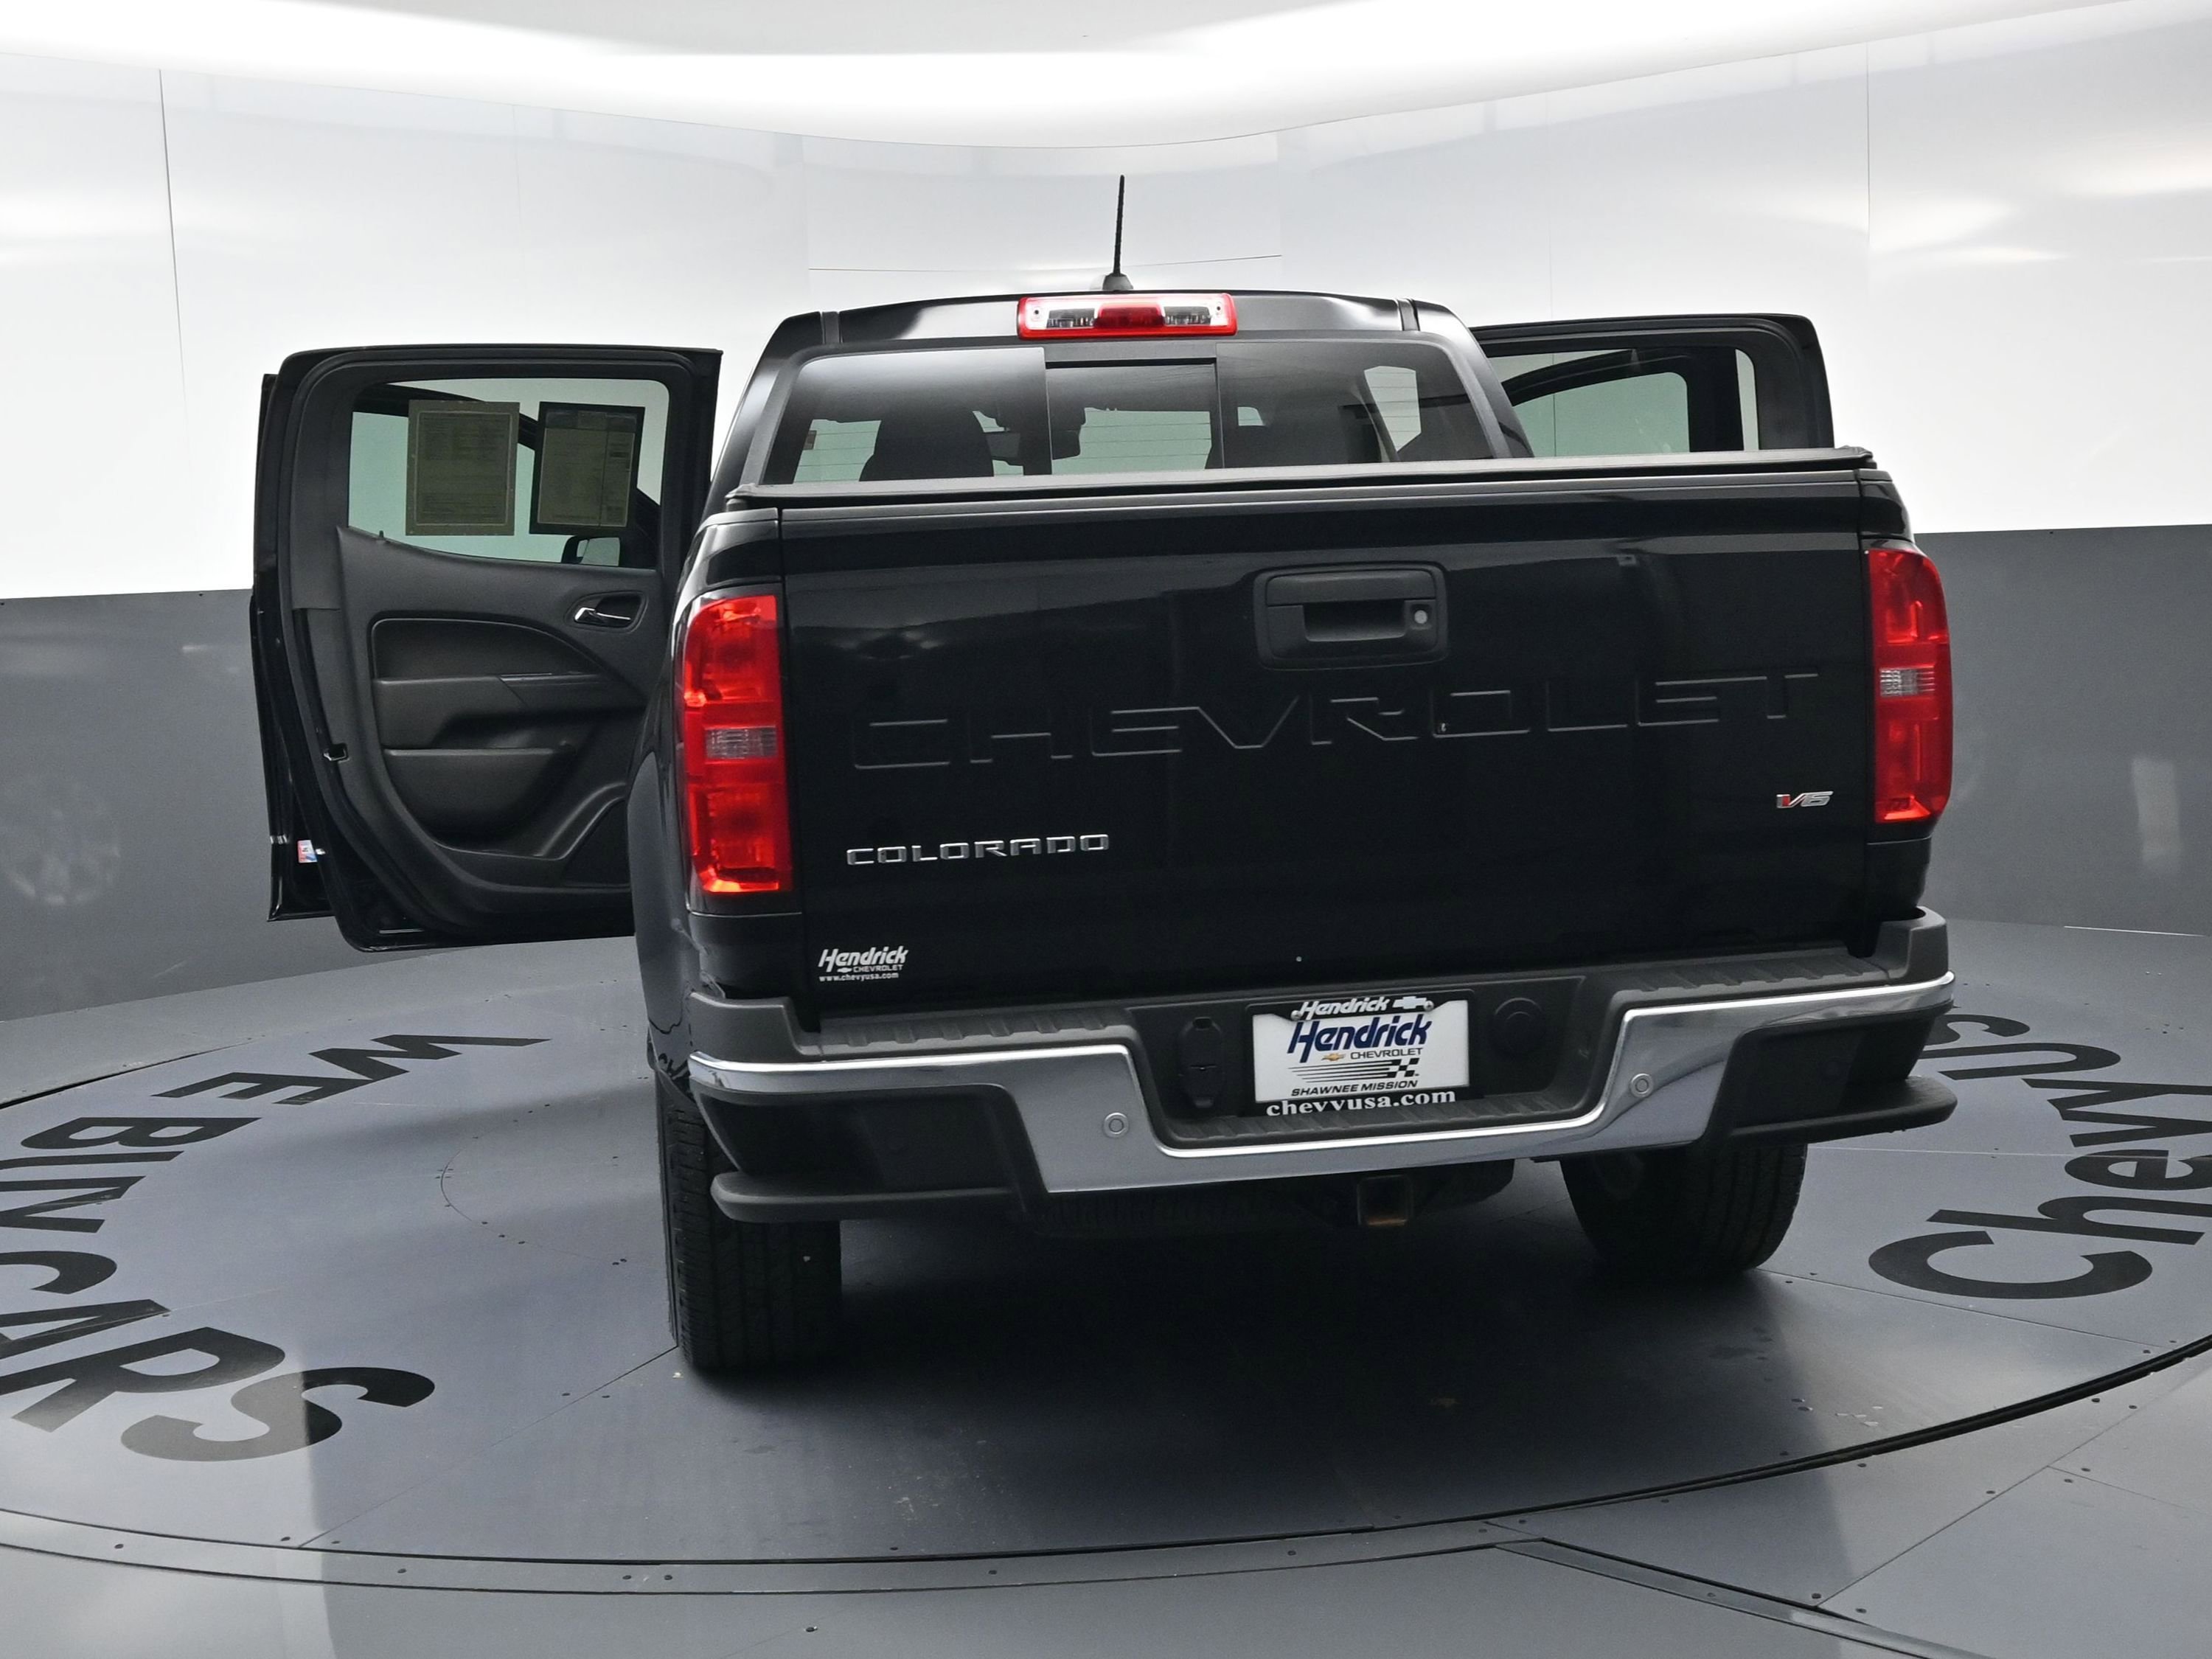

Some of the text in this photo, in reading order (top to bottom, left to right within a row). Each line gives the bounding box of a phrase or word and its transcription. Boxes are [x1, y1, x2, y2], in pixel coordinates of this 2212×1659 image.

[852, 665, 1821, 770] CHEVROLET
[1776, 790, 1834, 809] V6
[846, 834, 1110, 866] COLORADO
[817, 945, 908, 973] Hendrick
[852, 964, 903, 973] CHEVROLET
[818, 973, 899, 982] www.chevyusa.com
[1299, 996, 1391, 1020] Hendrick
[1287, 1014, 1433, 1063] Hendrick
[1350, 1047, 1424, 1060] CHEVROLET
[151, 1034, 551, 1105] WE
[1290, 1080, 1419, 1096] SHAWNEE MISSION
